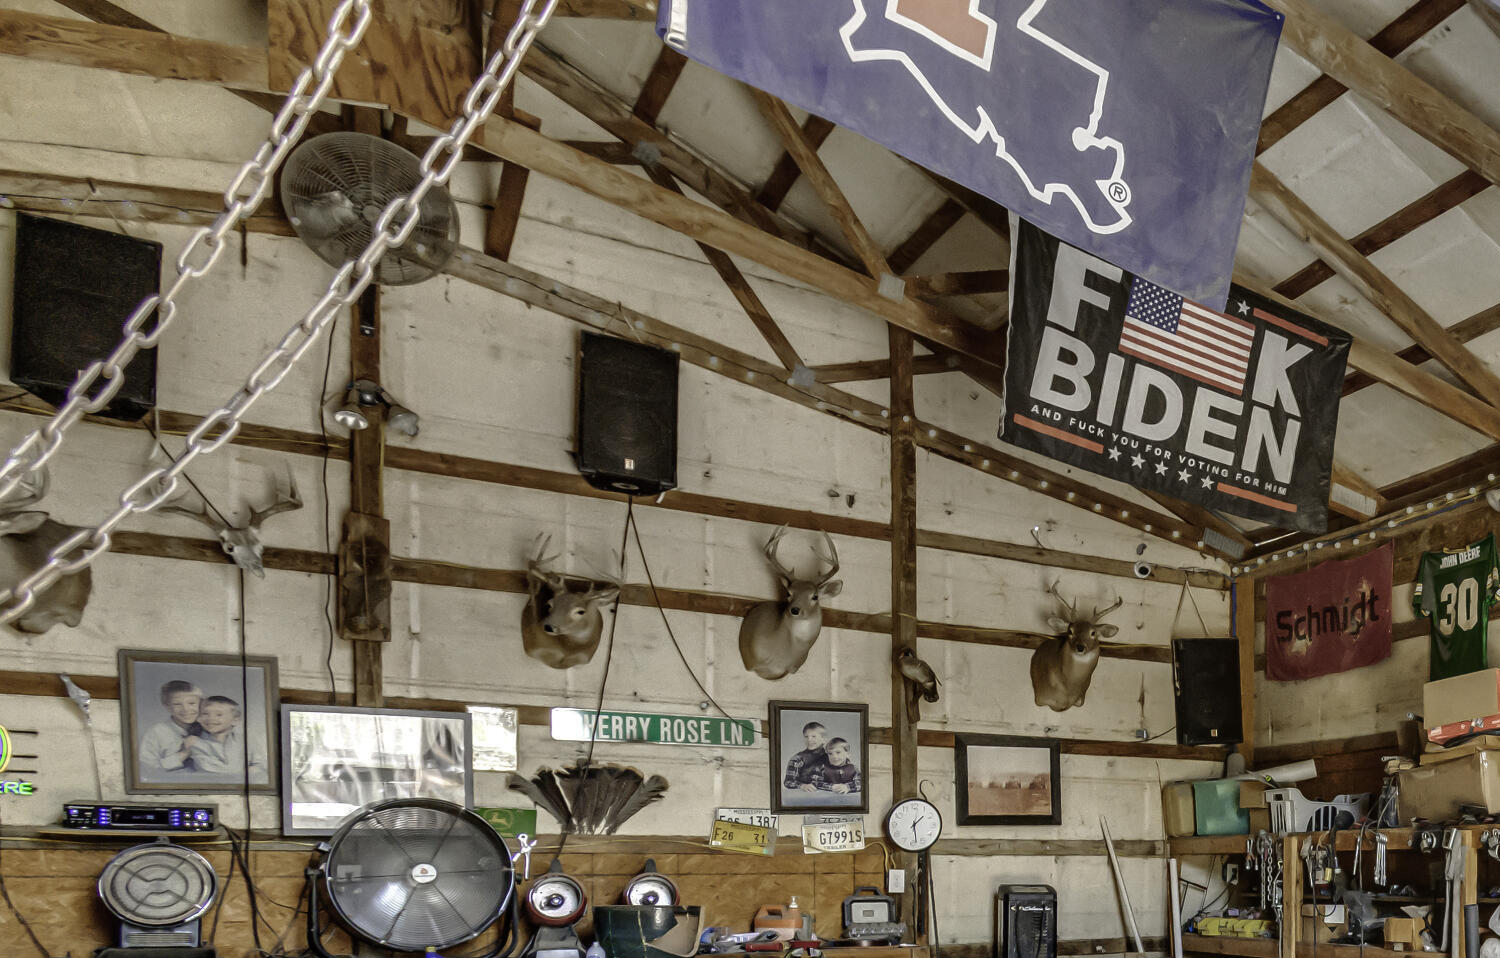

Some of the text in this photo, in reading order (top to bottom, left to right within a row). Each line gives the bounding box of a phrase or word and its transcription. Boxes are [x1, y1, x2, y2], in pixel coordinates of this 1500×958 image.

[1029, 326, 1301, 484] BIDEN
[1031, 404, 1288, 496] AND FUCK YOU FOR VOTING FOR HIM
[1440, 546, 1481, 569] JOHN DEERE
[1439, 577, 1479, 636] 30
[583, 713, 749, 746] HERRY ROSE LN.
